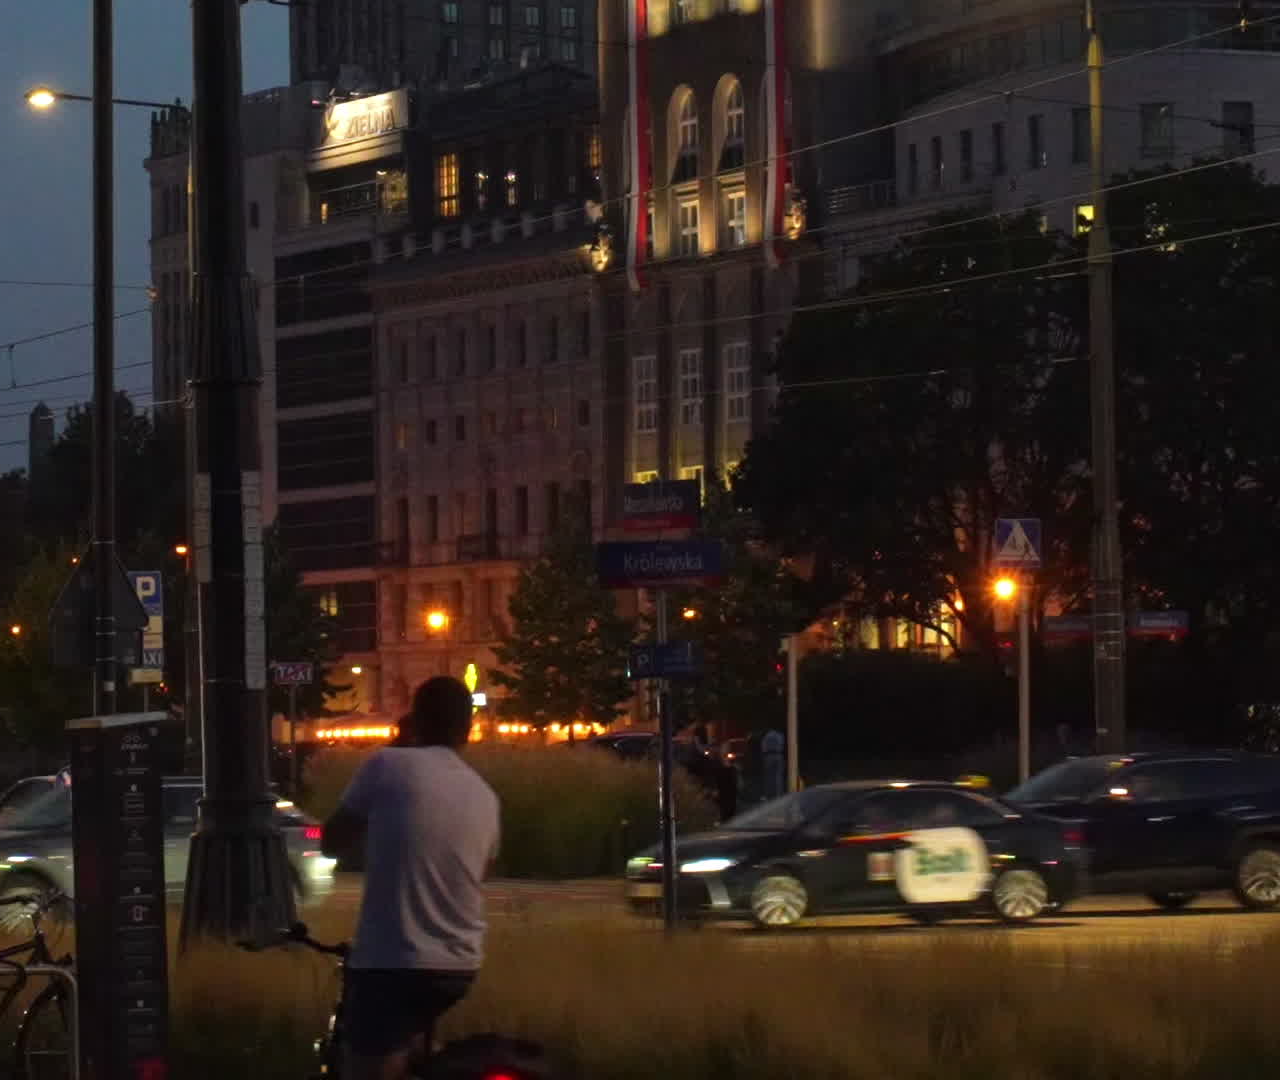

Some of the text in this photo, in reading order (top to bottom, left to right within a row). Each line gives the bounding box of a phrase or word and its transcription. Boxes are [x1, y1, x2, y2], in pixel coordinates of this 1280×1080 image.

[623, 551, 704, 571] Królewska
[136, 576, 157, 602] P
[143, 650, 163, 666] AXI
